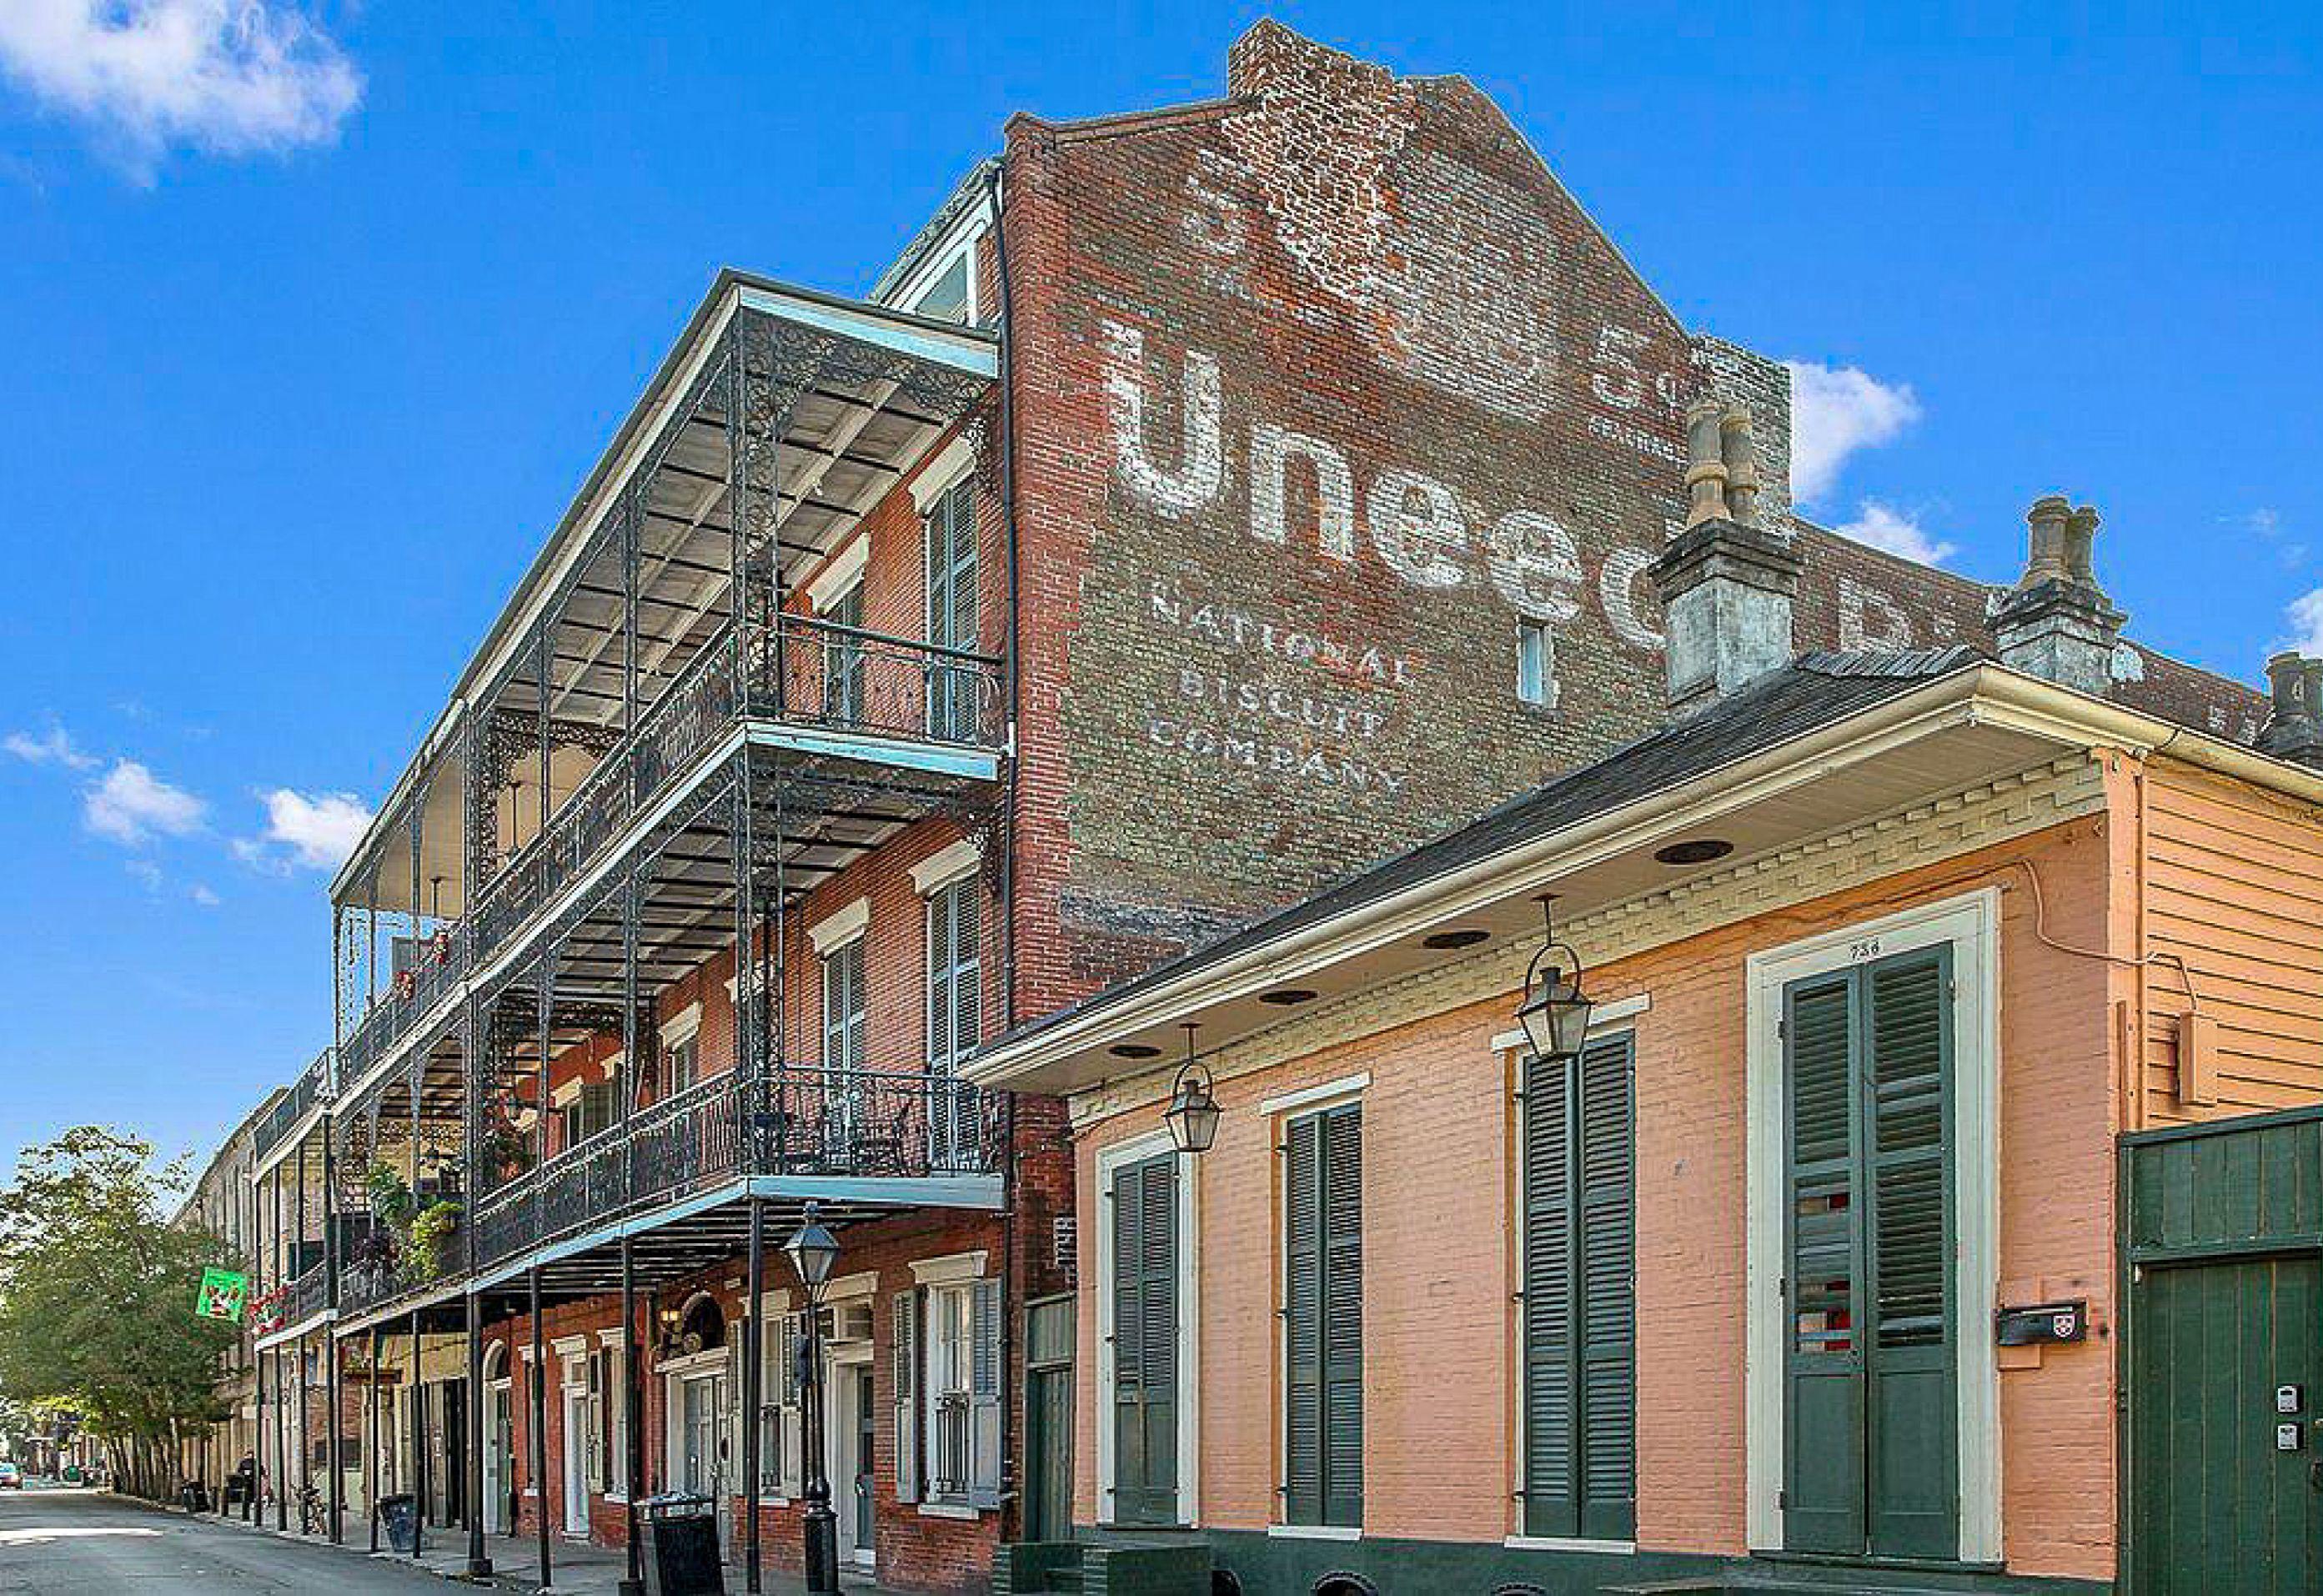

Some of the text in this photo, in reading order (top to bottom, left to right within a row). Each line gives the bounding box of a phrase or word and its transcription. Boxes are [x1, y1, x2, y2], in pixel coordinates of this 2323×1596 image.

[1151, 593, 1414, 686] NATIONAL
[1180, 670, 1383, 738] BISCUIT
[1150, 720, 1408, 790] COMPANY
